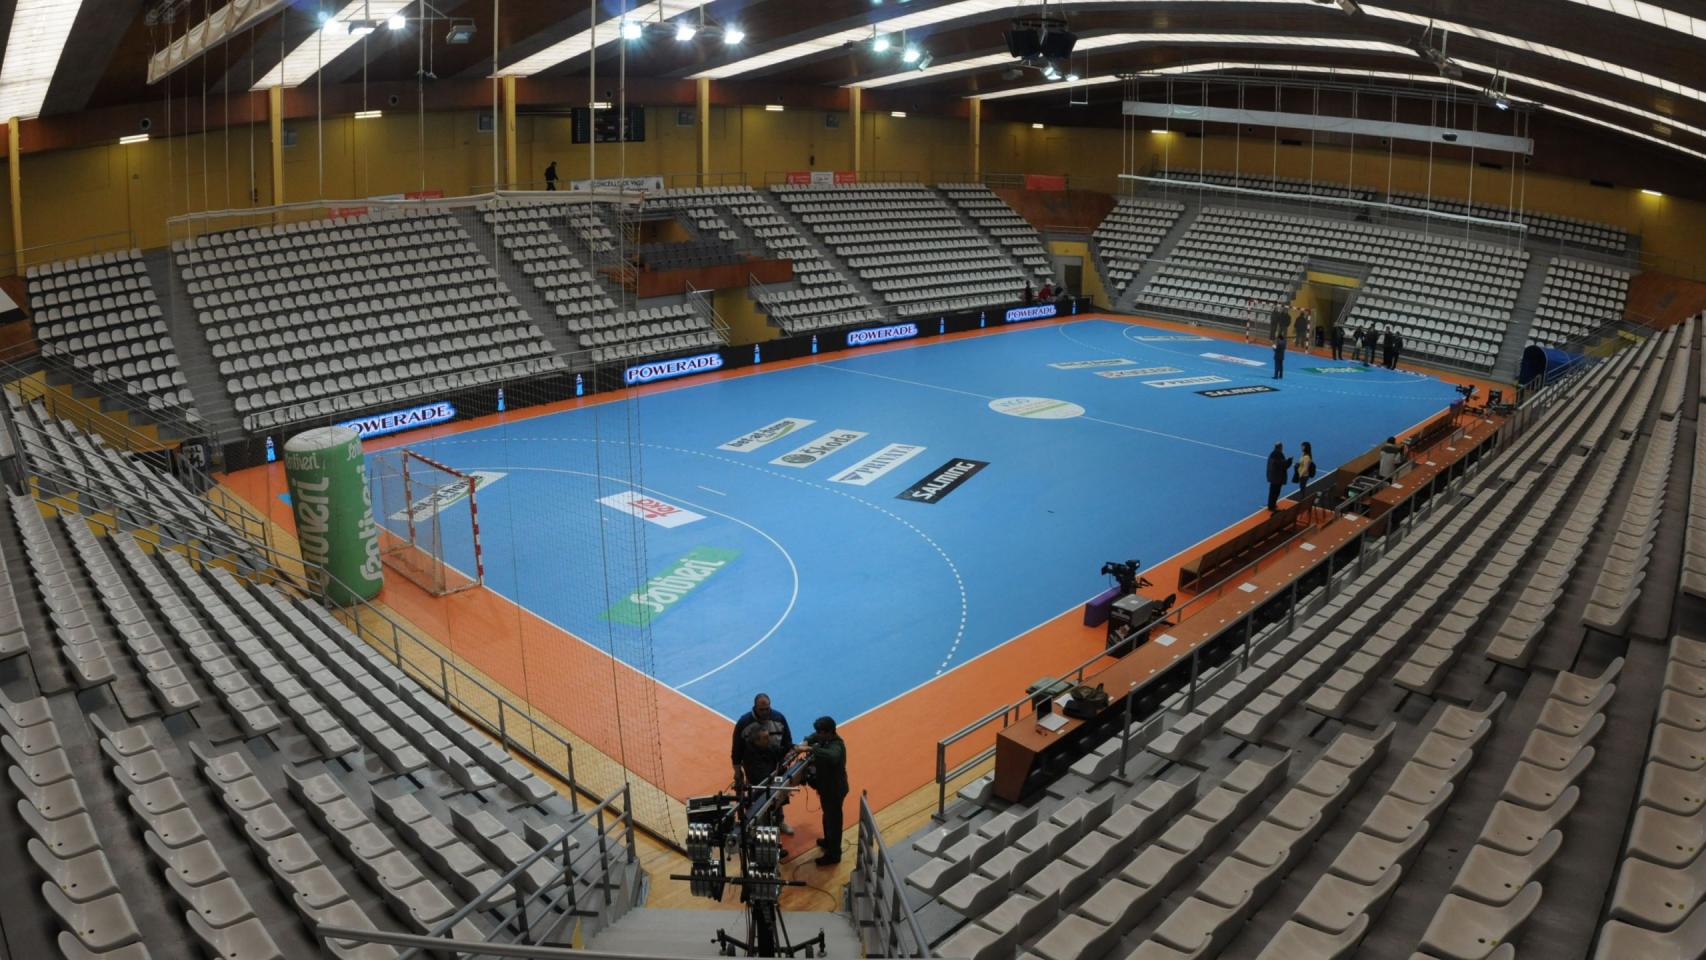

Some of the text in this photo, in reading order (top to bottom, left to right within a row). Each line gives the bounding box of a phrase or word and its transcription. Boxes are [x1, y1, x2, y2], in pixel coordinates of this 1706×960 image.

[1008, 305, 1054, 319] POWERADE
[850, 325, 915, 343] POWERADE
[628, 356, 716, 380] POWERADE
[348, 405, 447, 434] OWERADE
[727, 420, 796, 447] bet-at-home
[855, 445, 917, 474] PRIVATA
[911, 461, 976, 501] SALMING
[630, 558, 726, 613] Santiveri
